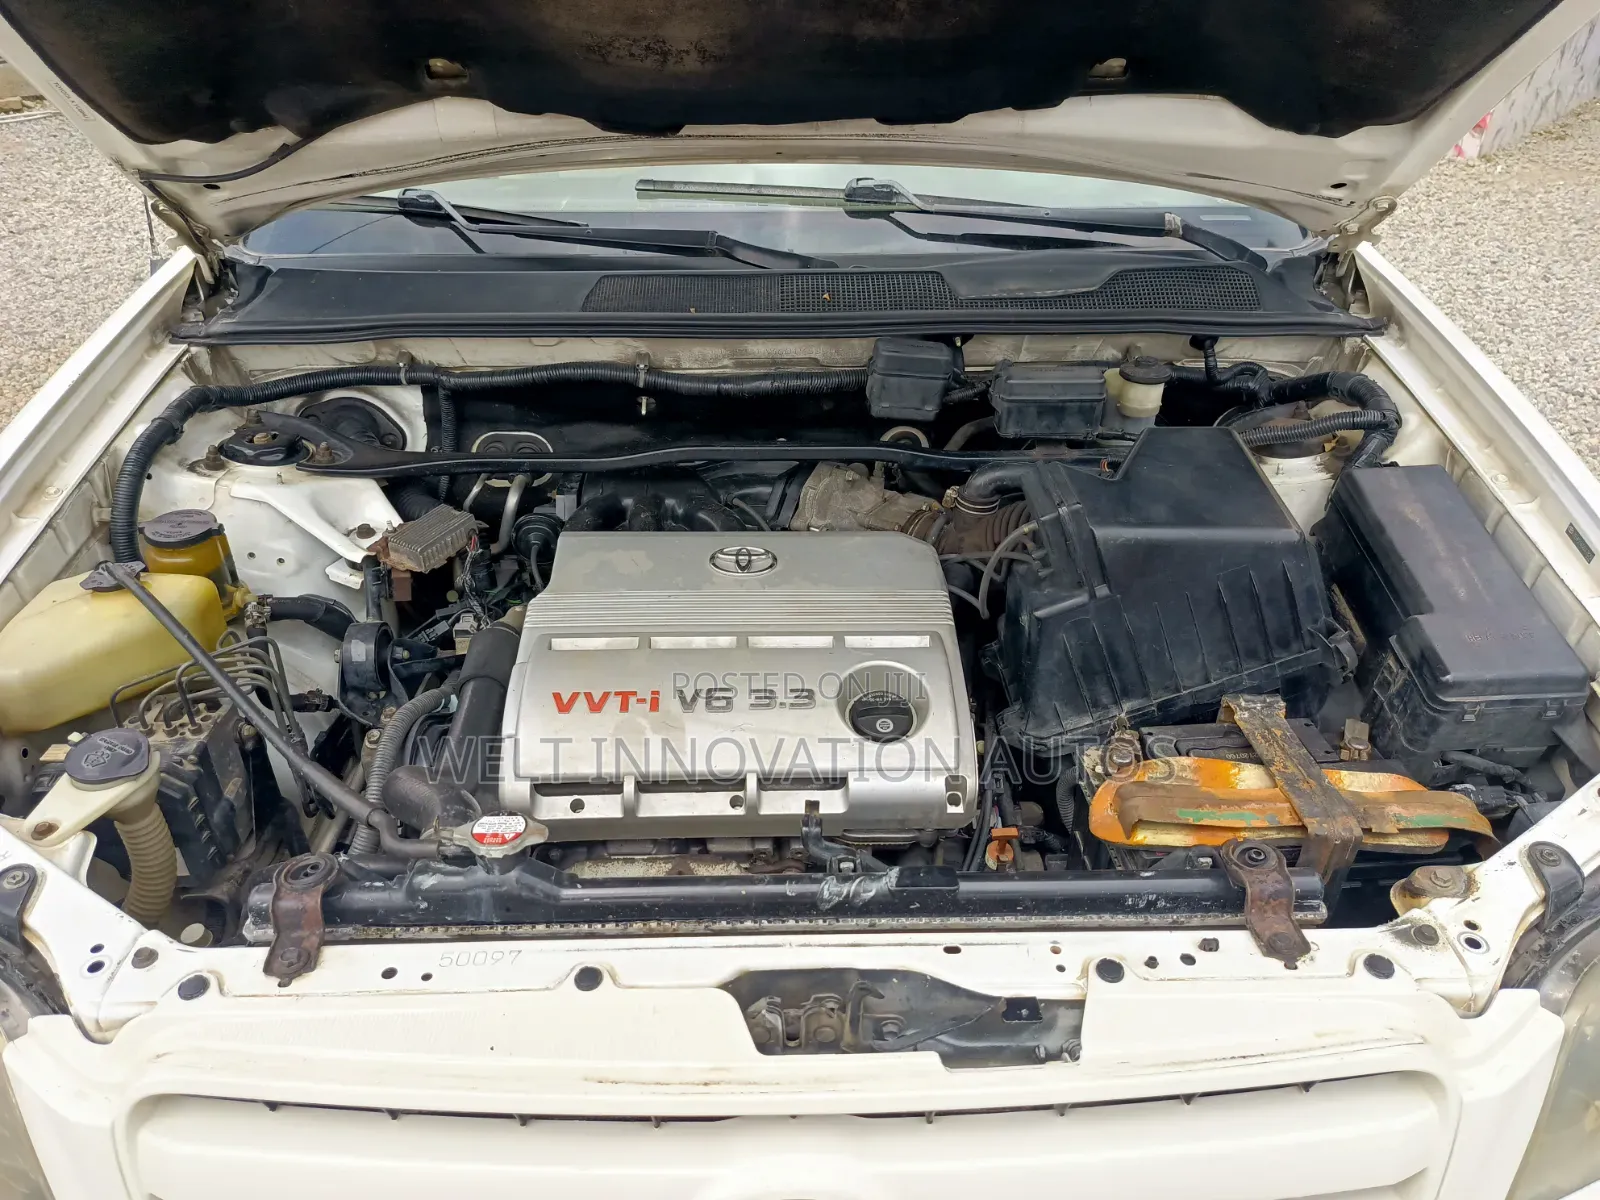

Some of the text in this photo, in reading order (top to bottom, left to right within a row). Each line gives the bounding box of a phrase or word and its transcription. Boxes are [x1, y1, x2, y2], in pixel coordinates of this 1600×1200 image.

[551, 687, 818, 714] VVT-i V6 3.3
[438, 949, 523, 968] 50097
